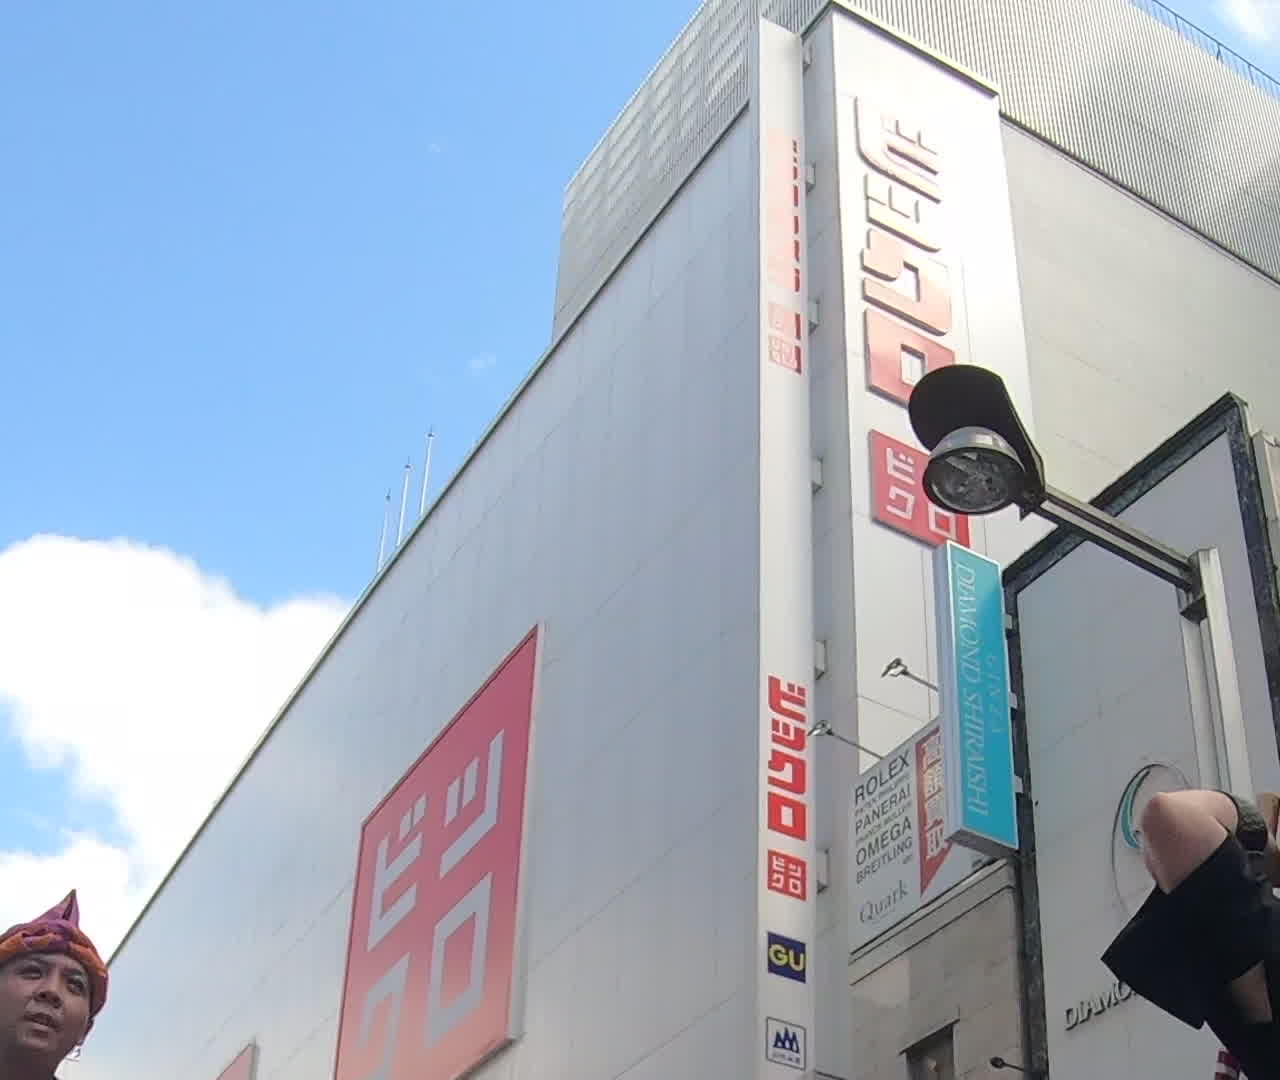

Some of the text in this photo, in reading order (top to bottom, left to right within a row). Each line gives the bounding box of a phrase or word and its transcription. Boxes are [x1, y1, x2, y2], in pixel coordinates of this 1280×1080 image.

[854, 749, 911, 807] ROLEX
[855, 783, 911, 836] PANERAI
[855, 835, 913, 885] BREITLING
[856, 815, 912, 866] OMEGA
[859, 879, 910, 924] Quark
[769, 942, 806, 973] GU
